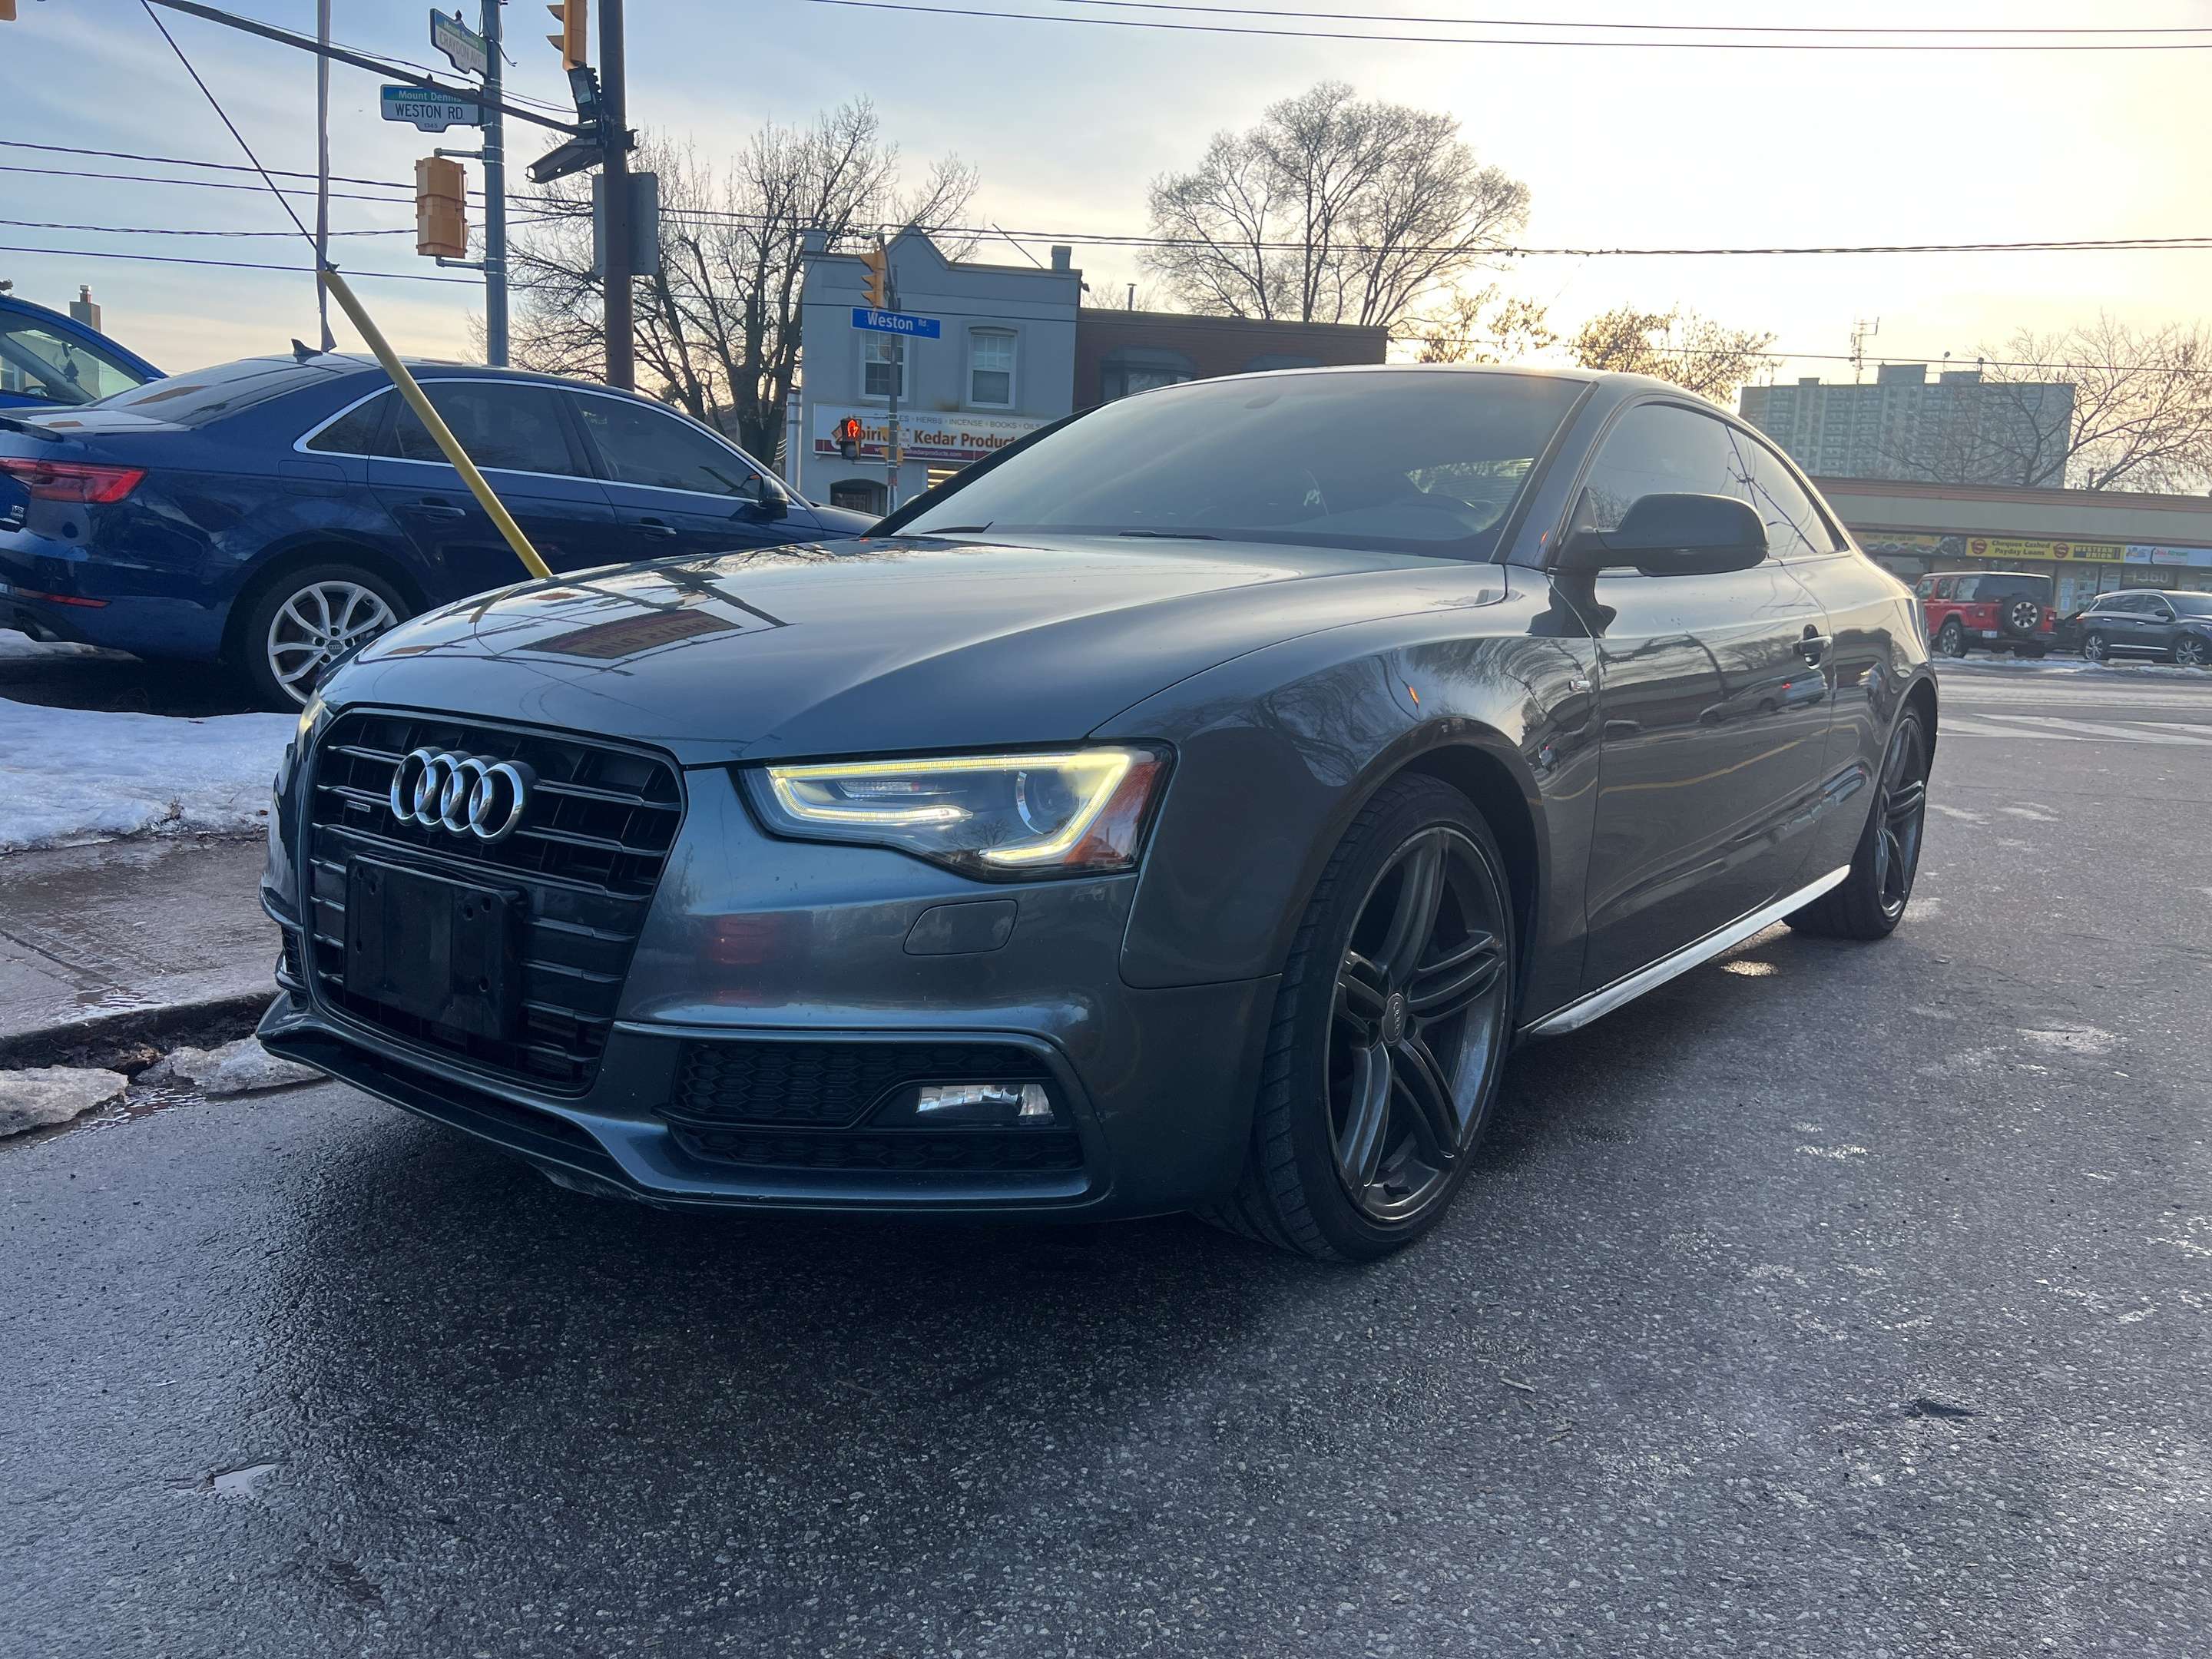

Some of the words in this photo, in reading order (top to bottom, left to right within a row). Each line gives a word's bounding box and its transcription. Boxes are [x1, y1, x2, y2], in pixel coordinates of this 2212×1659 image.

[399, 90, 427, 101] Mount
[395, 102, 442, 119] WESTON
[866, 311, 913, 331] Weston
[916, 416, 942, 425] HERBS
[949, 419, 982, 427] INCENSE
[989, 421, 1017, 429] BOOKS
[914, 429, 956, 445] Kedar
